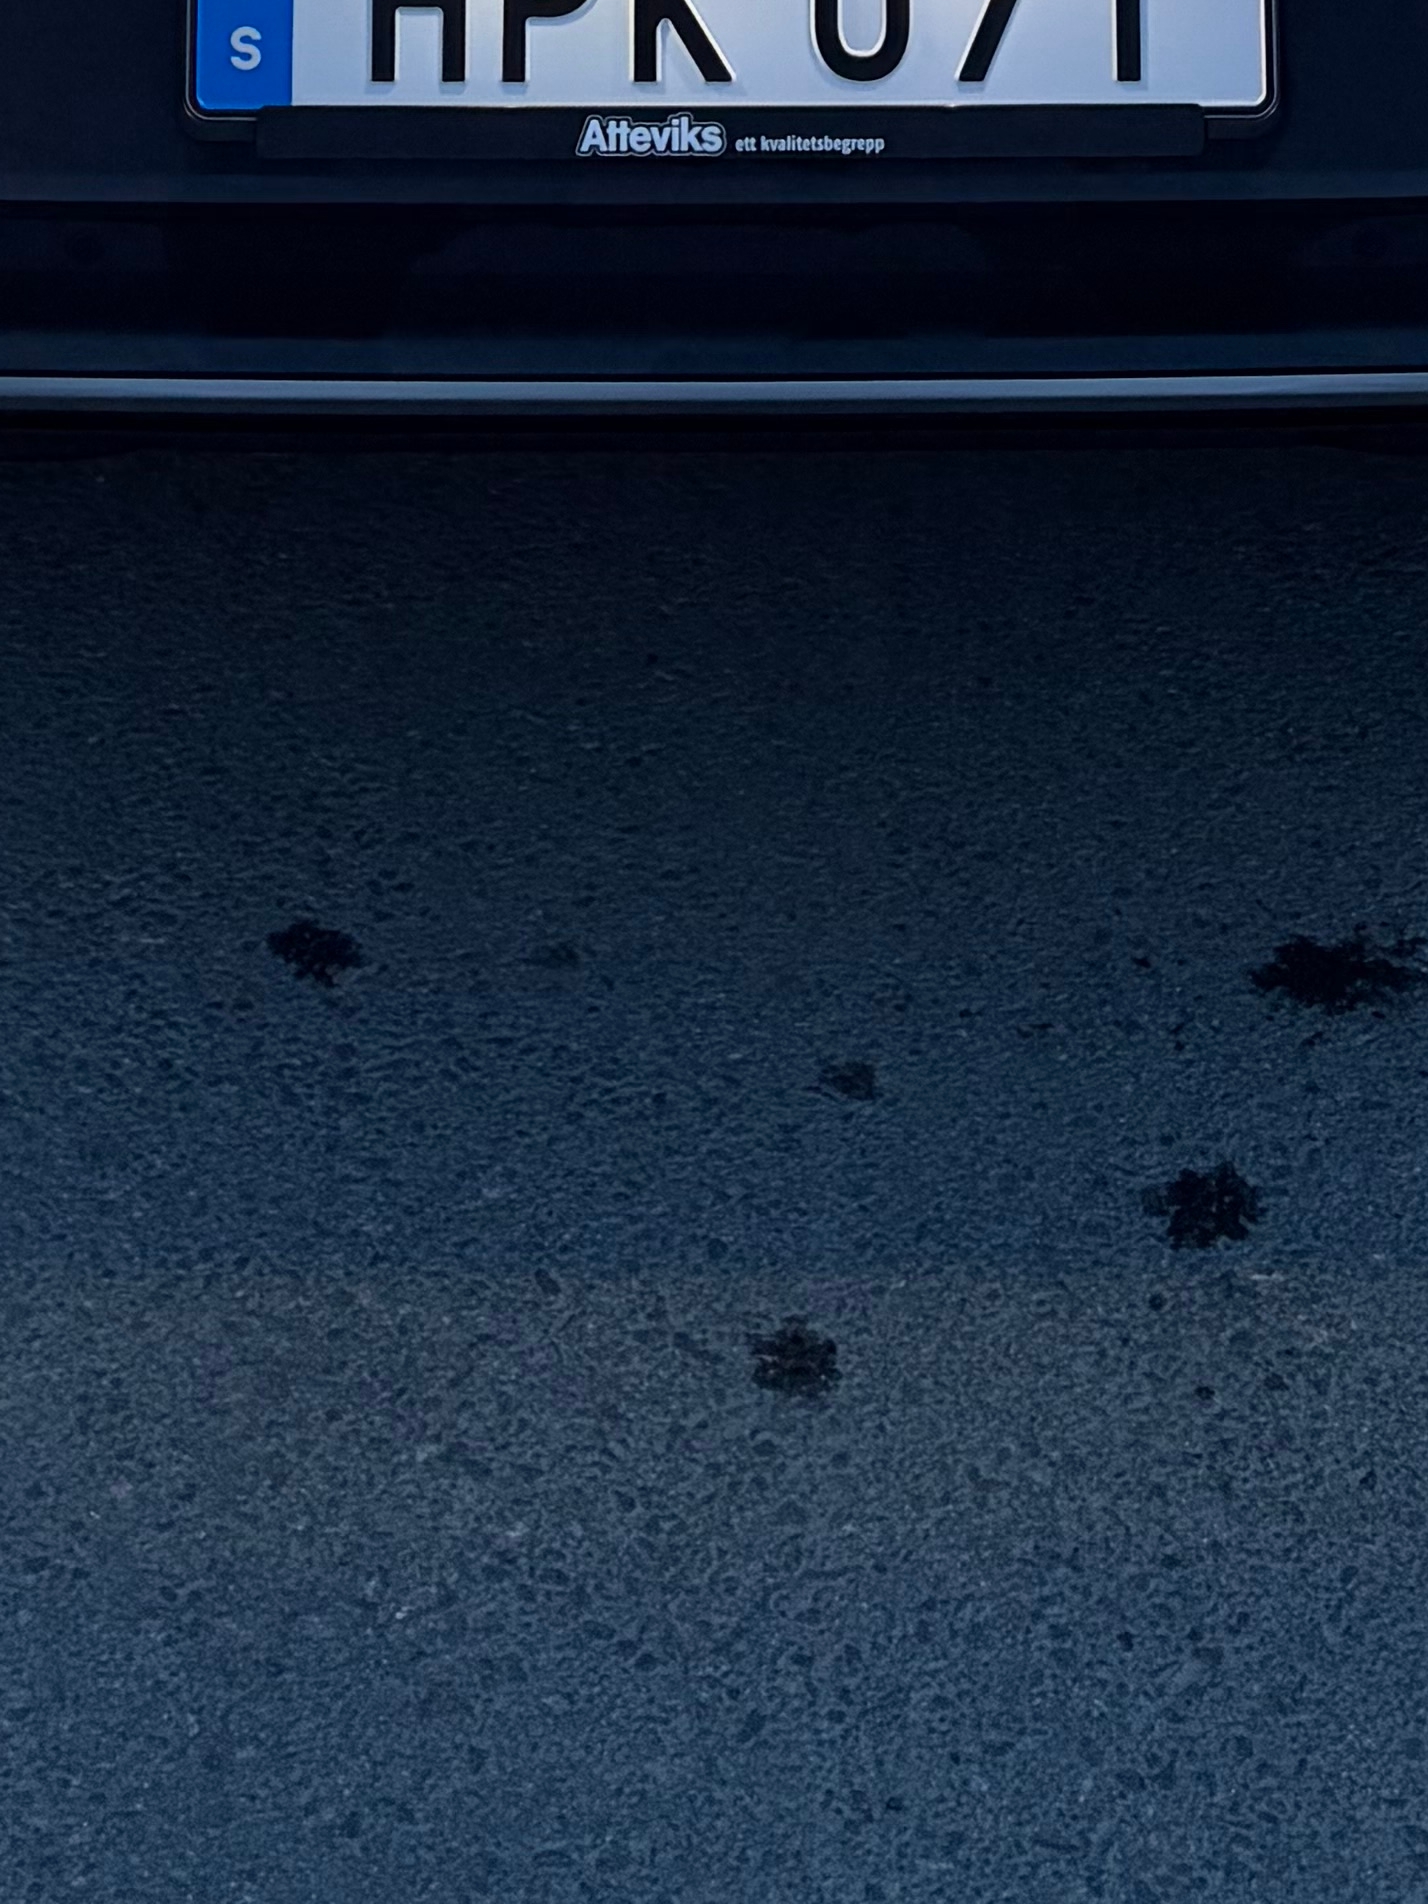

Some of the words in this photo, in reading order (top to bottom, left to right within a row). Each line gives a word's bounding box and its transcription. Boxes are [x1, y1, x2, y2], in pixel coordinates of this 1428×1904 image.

[230, 26, 262, 71] S
[578, 115, 724, 153] Atteviks
[735, 137, 758, 152] ett
[761, 135, 885, 155] kvalitetsbegrepp
